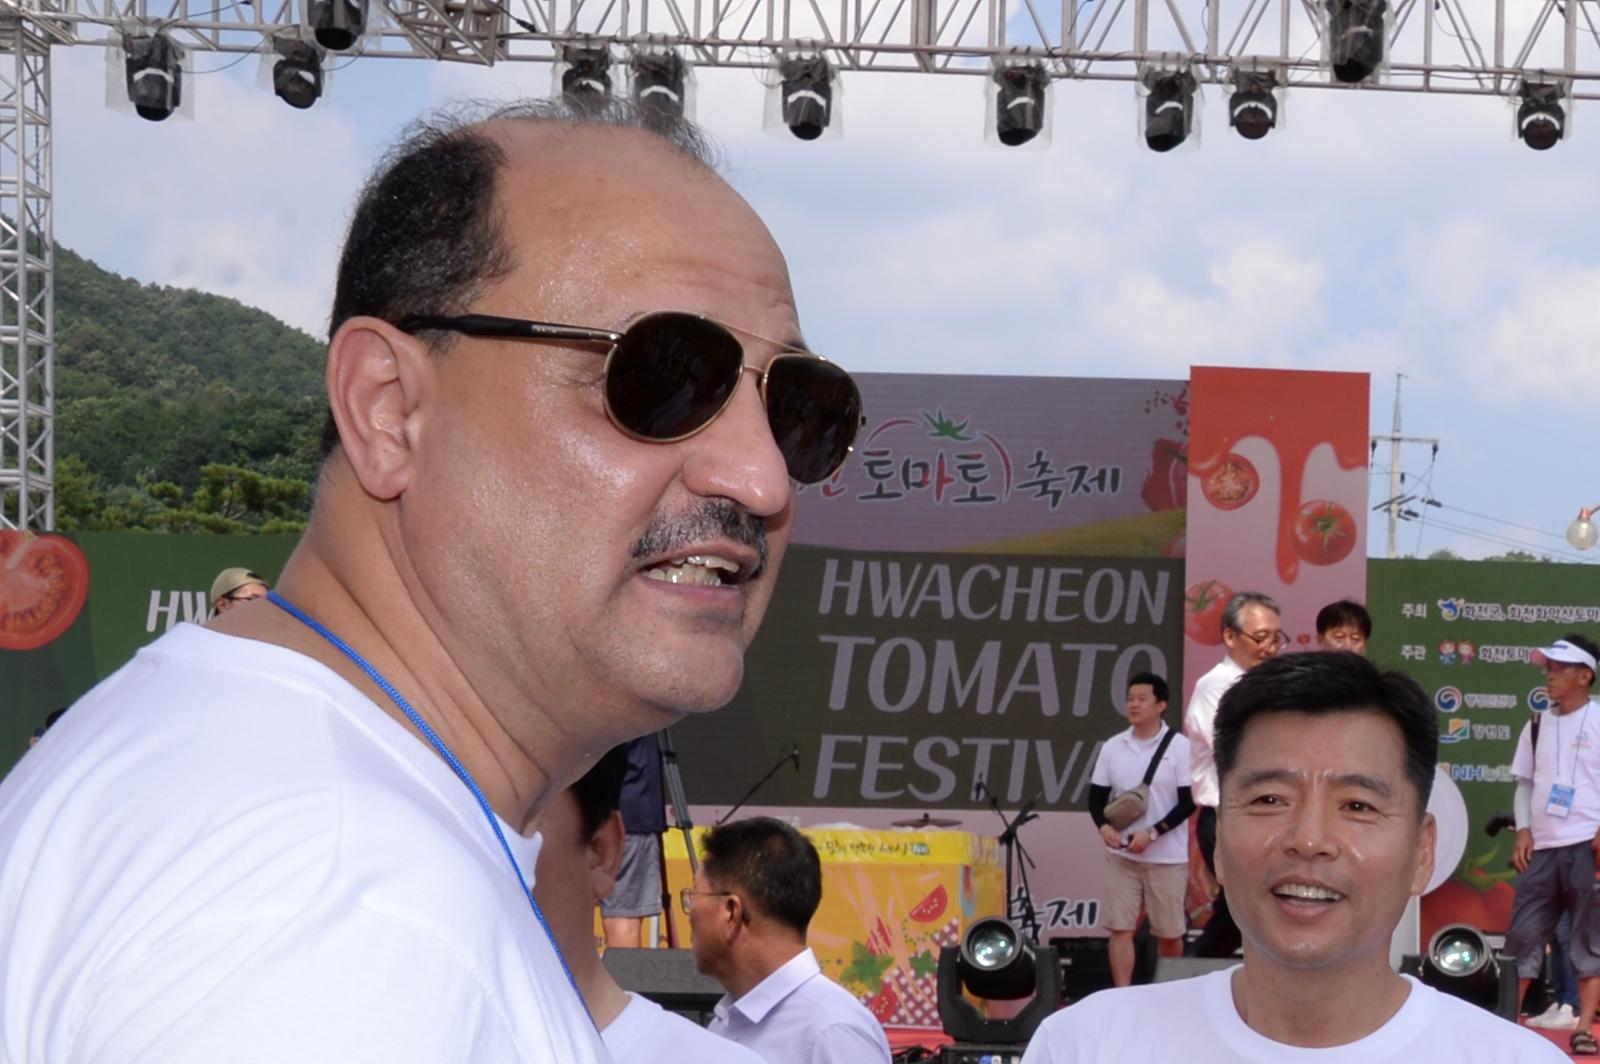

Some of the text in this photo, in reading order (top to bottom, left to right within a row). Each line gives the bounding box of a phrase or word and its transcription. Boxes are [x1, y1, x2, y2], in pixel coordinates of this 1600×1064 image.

[858, 449, 998, 503] 토마토
[1017, 450, 1121, 509] 축제
[818, 559, 1170, 625] HWACHEON
[1402, 603, 1427, 618] 주최
[819, 635, 1167, 717] TOMATO
[813, 734, 1103, 804] FESTIV
